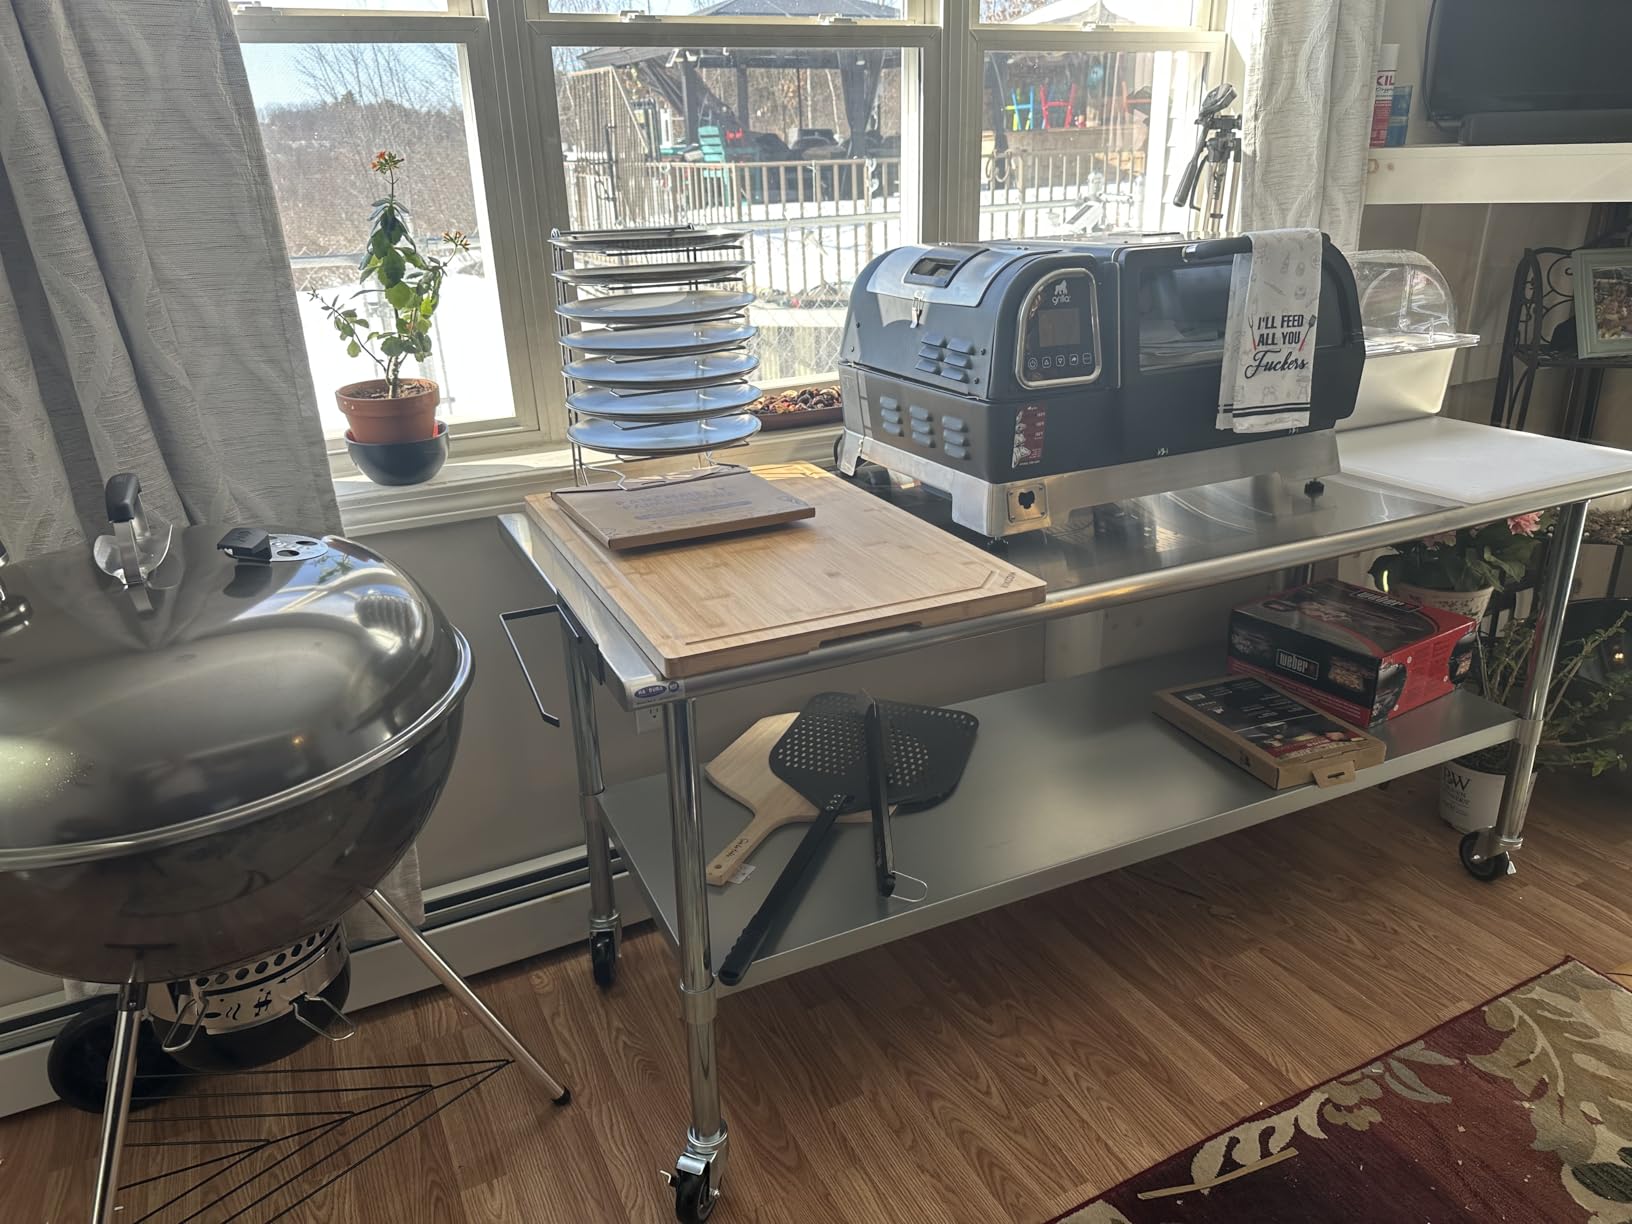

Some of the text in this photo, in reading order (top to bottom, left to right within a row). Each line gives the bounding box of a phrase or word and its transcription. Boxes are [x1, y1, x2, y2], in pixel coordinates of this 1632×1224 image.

[1257, 314, 1305, 330] I'LL FEED
[1257, 331, 1301, 347] ALL YOU
[1244, 348, 1309, 380] Fuckers
[1279, 652, 1309, 674] weber
